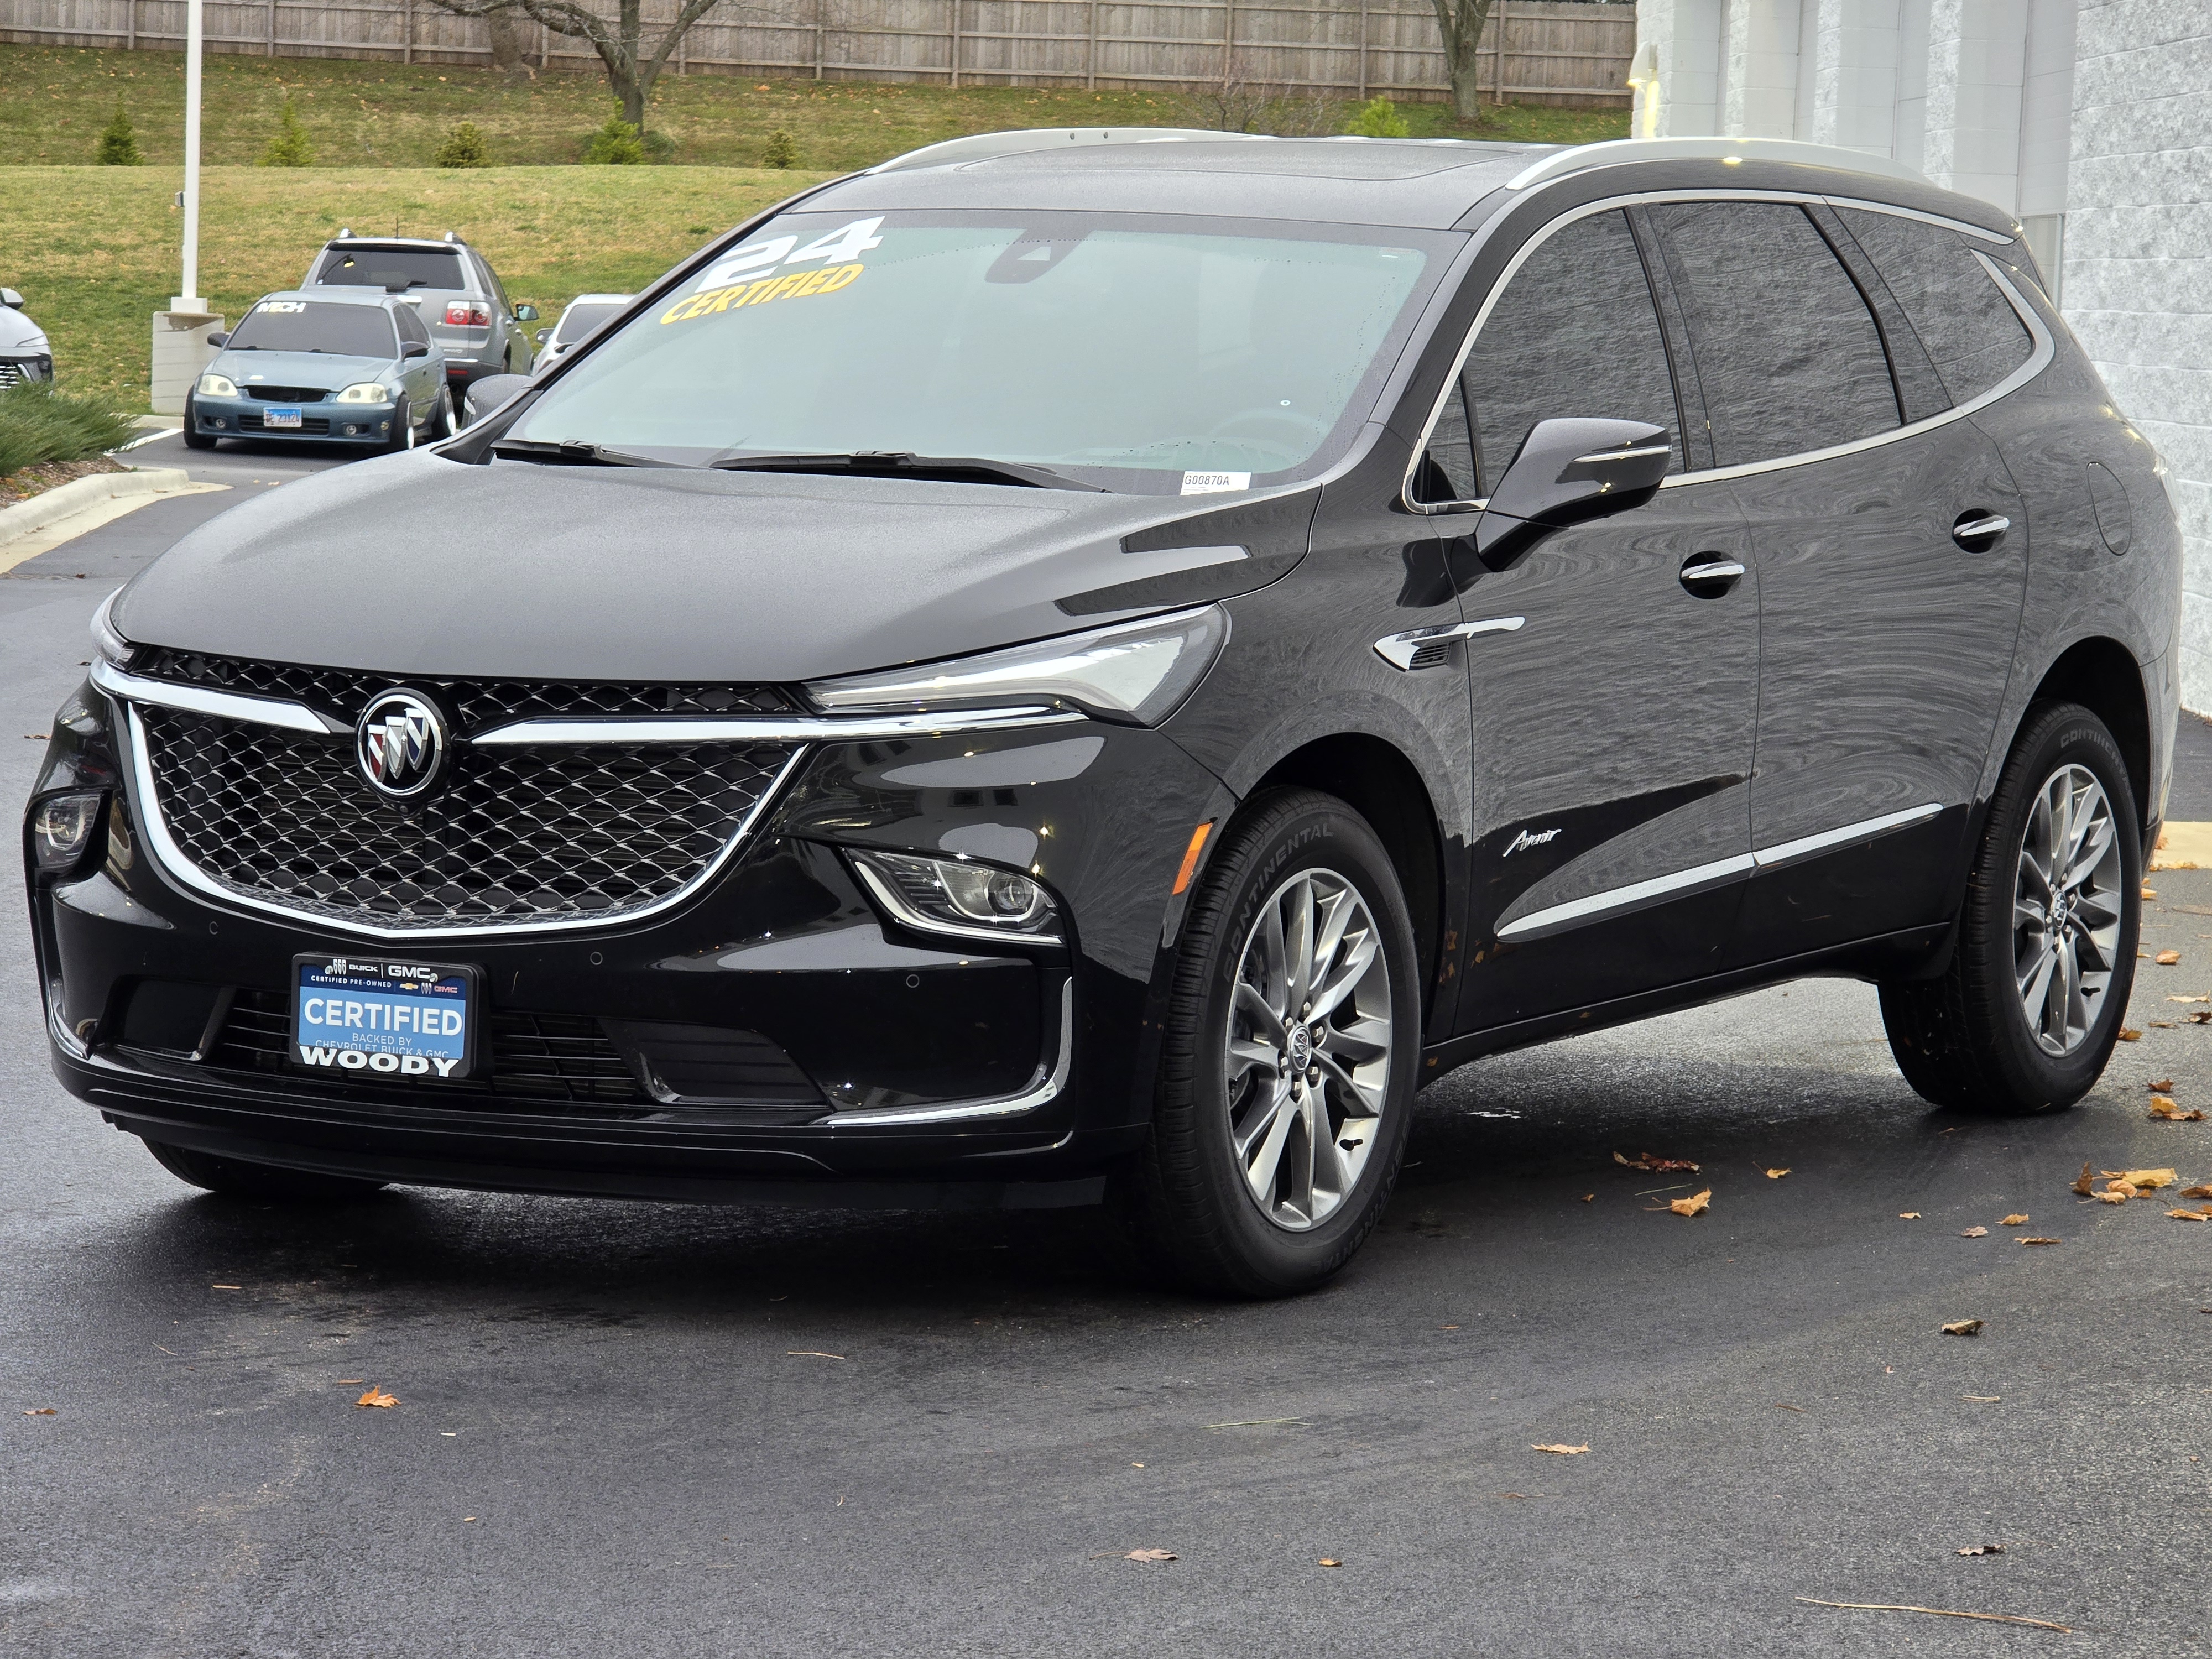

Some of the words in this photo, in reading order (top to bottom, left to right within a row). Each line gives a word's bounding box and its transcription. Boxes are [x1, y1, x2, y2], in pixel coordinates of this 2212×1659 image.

[695, 216, 885, 293] 24
[660, 264, 864, 325] CERTIFIED
[1185, 475, 1230, 485] G00870A
[1223, 823, 1334, 983] CONTINENTAL
[311, 975, 348, 984] CERTIFIED
[349, 978, 392, 988] PRE-OWNED
[348, 964, 378, 972] BUICK
[388, 965, 431, 979] GMC
[304, 998, 462, 1036] CERTIFIED
[352, 1032, 395, 1045] BACKED
[399, 1037, 412, 1046] BY
[381, 1046, 413, 1055] BUICK
[299, 1046, 459, 1077] WOODY
